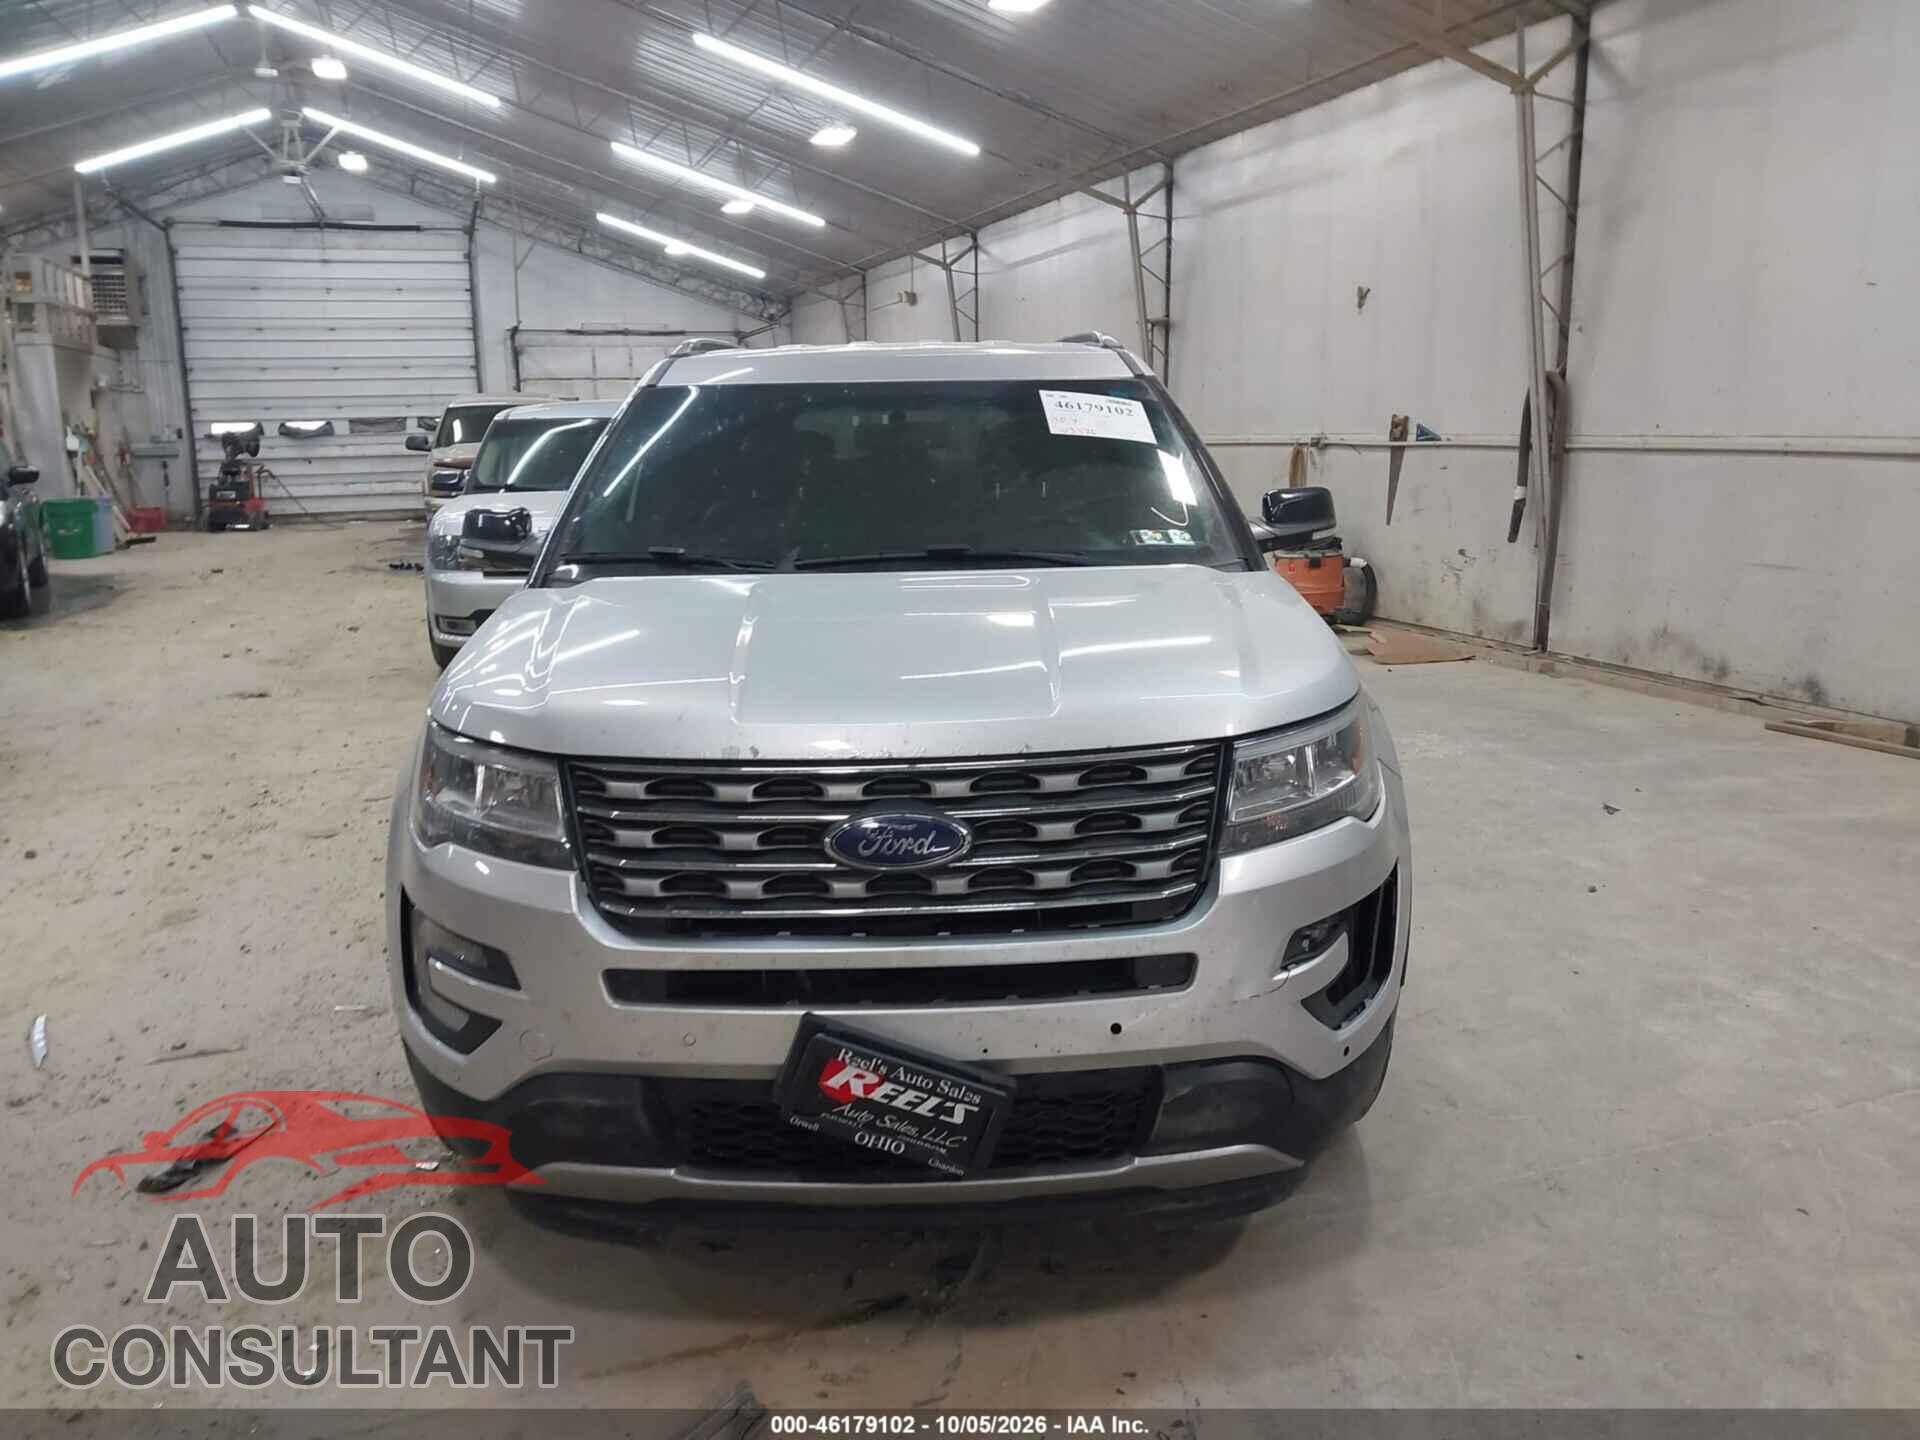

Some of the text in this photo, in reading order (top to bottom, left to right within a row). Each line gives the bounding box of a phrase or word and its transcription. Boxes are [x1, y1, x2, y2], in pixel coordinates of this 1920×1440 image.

[1055, 401, 1134, 416] 46179102
[857, 823, 950, 857] Ford
[837, 1047, 981, 1105] Reel's Auto Sales
[826, 1065, 979, 1124] REEL'S
[832, 1103, 874, 1124] Auto
[854, 1130, 906, 1156] OHIO
